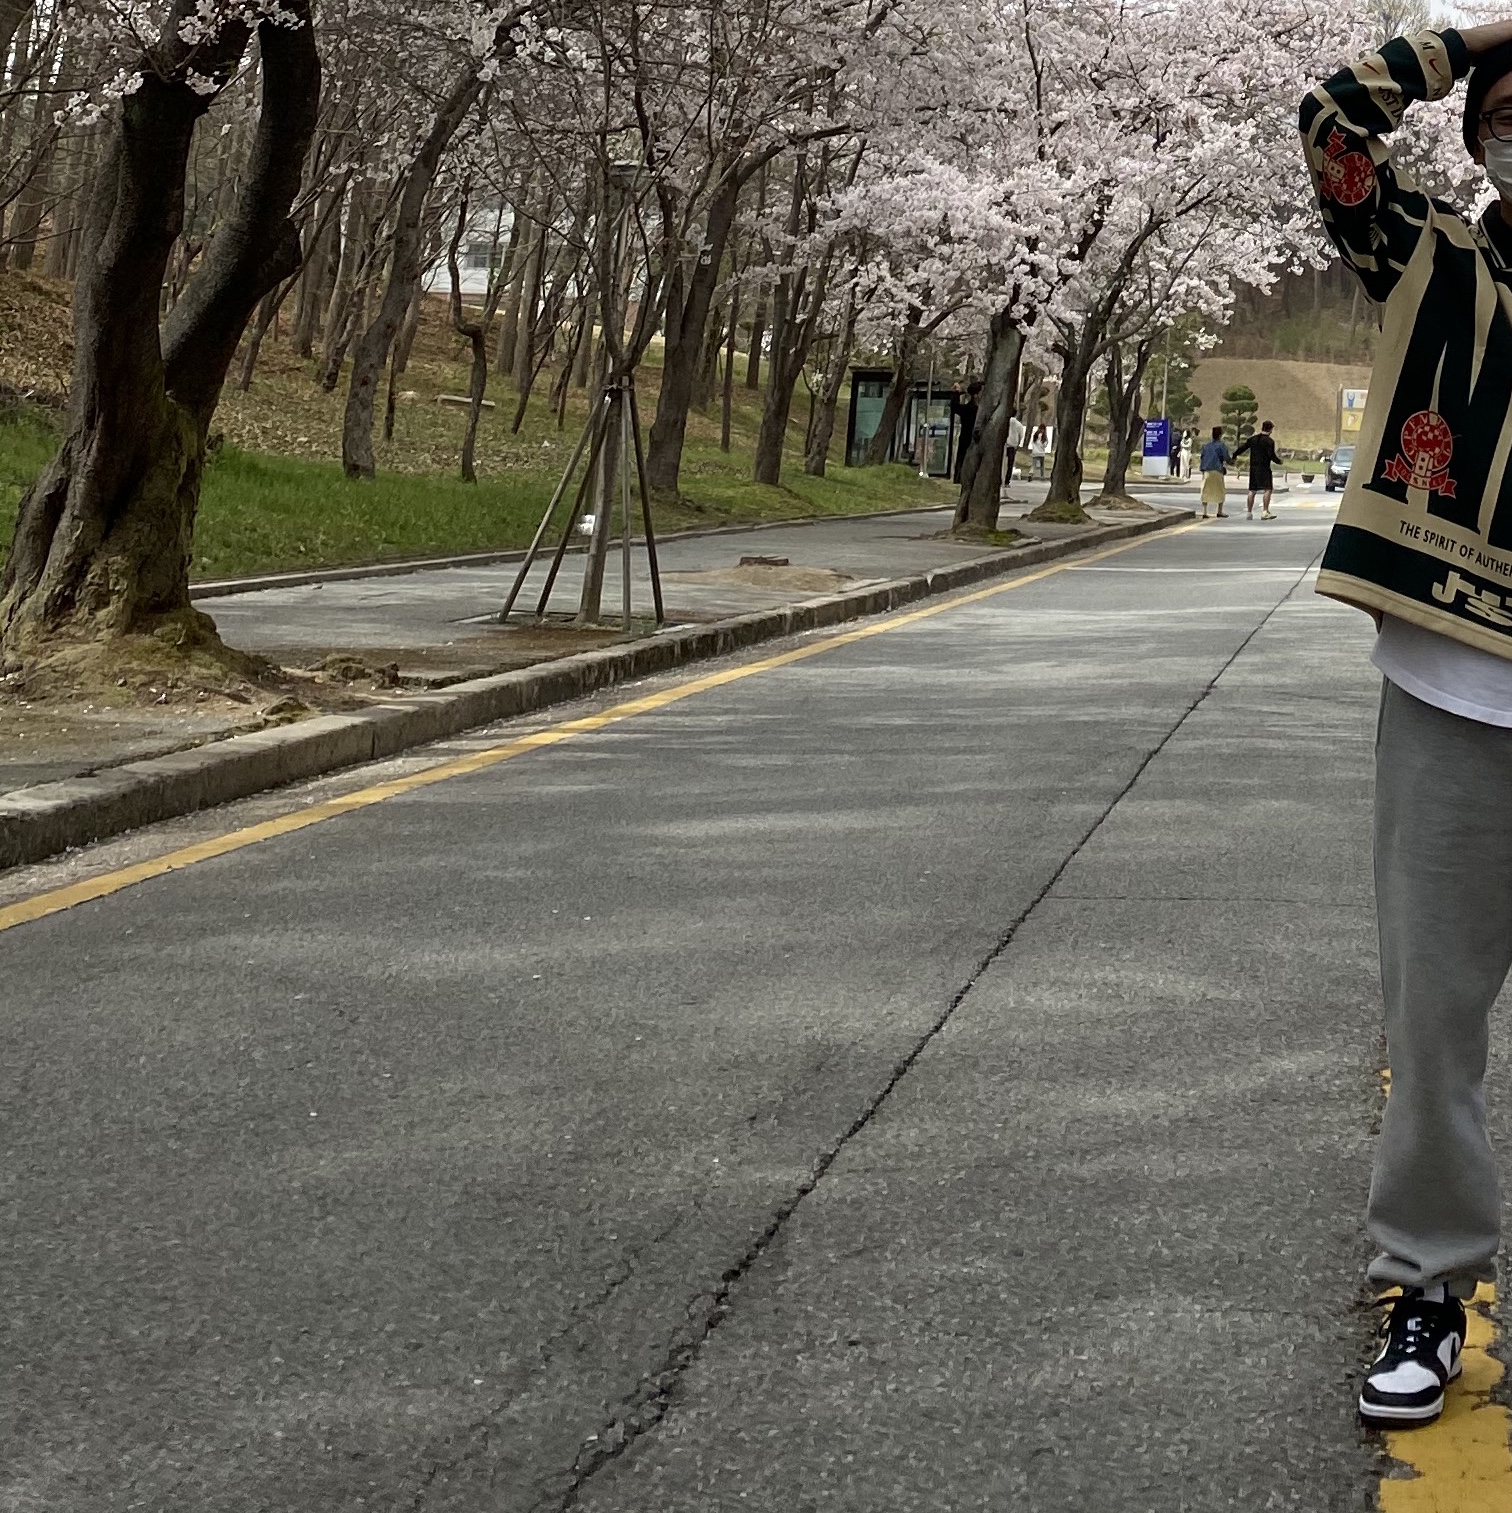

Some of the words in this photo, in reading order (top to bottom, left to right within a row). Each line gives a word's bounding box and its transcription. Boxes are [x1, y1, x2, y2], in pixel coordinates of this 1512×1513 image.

[1400, 520, 1421, 539] THE
[1423, 529, 1457, 553] SPIRIT
[1459, 544, 1475, 560] OF
